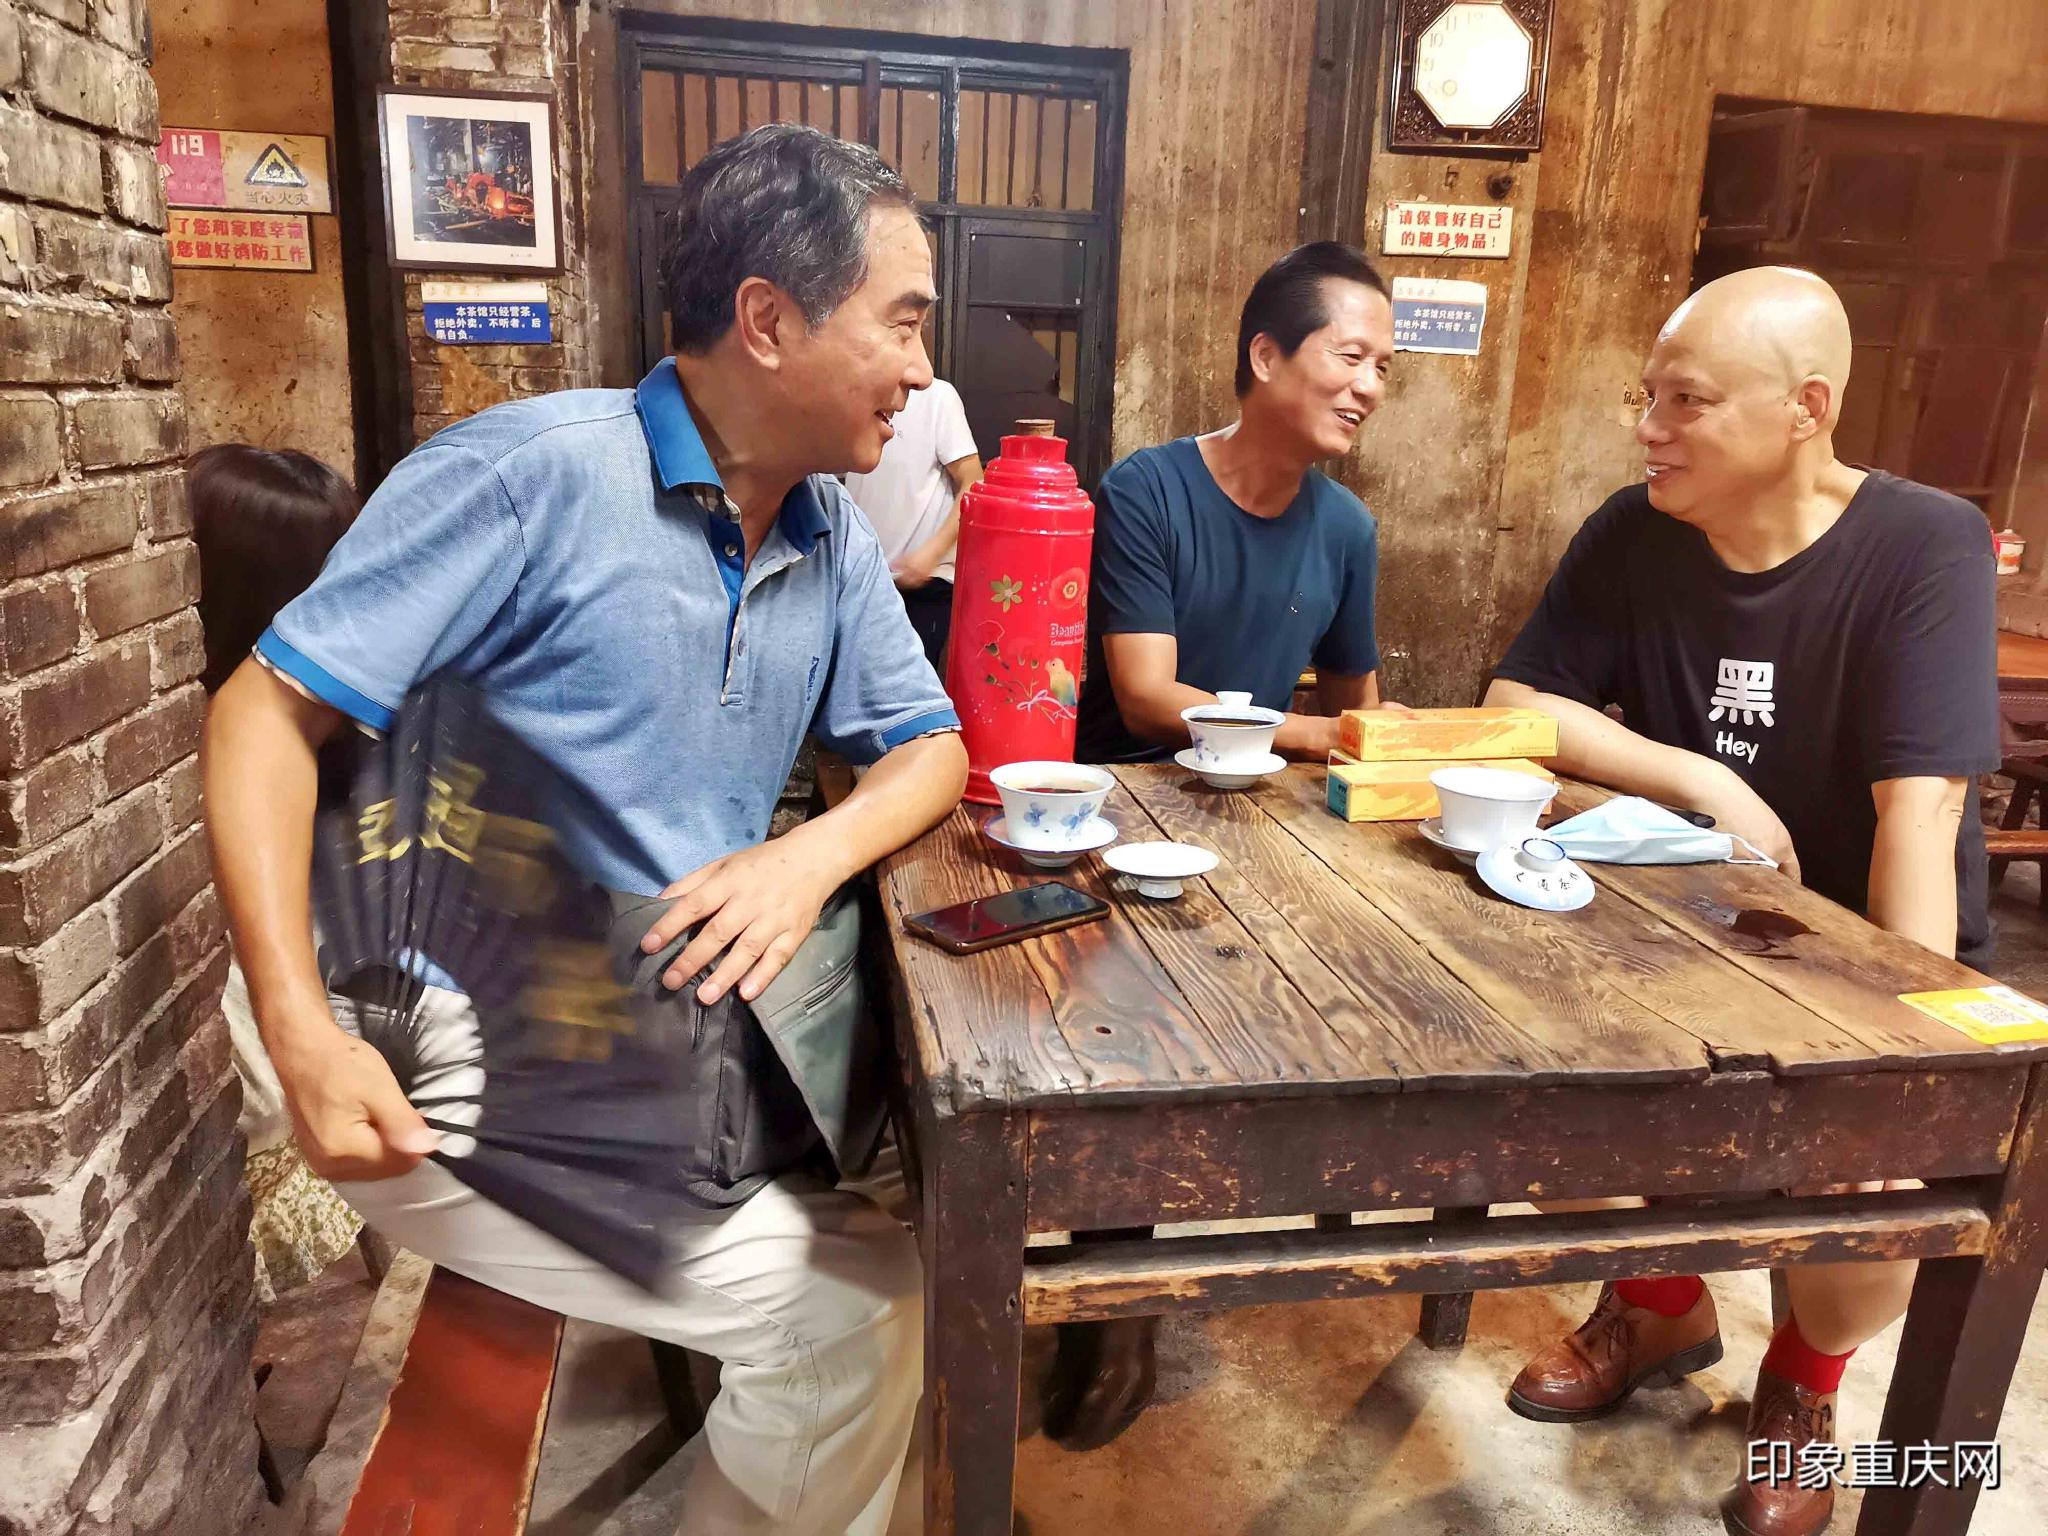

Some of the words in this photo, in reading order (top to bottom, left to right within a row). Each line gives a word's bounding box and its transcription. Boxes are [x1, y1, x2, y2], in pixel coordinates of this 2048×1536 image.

[1430, 33, 1443, 48] 10
[171, 134, 204, 157] 119
[245, 190, 311, 207] 当心火灾
[167, 216, 304, 240] 了您和家庭幸福
[1399, 209, 1502, 230] 请保管好自己
[168, 239, 306, 263] 您做好消防工作
[1401, 230, 1496, 250] 的随身物品！
[1708, 658, 1776, 728] 黑
[1715, 731, 1760, 766] Hey
